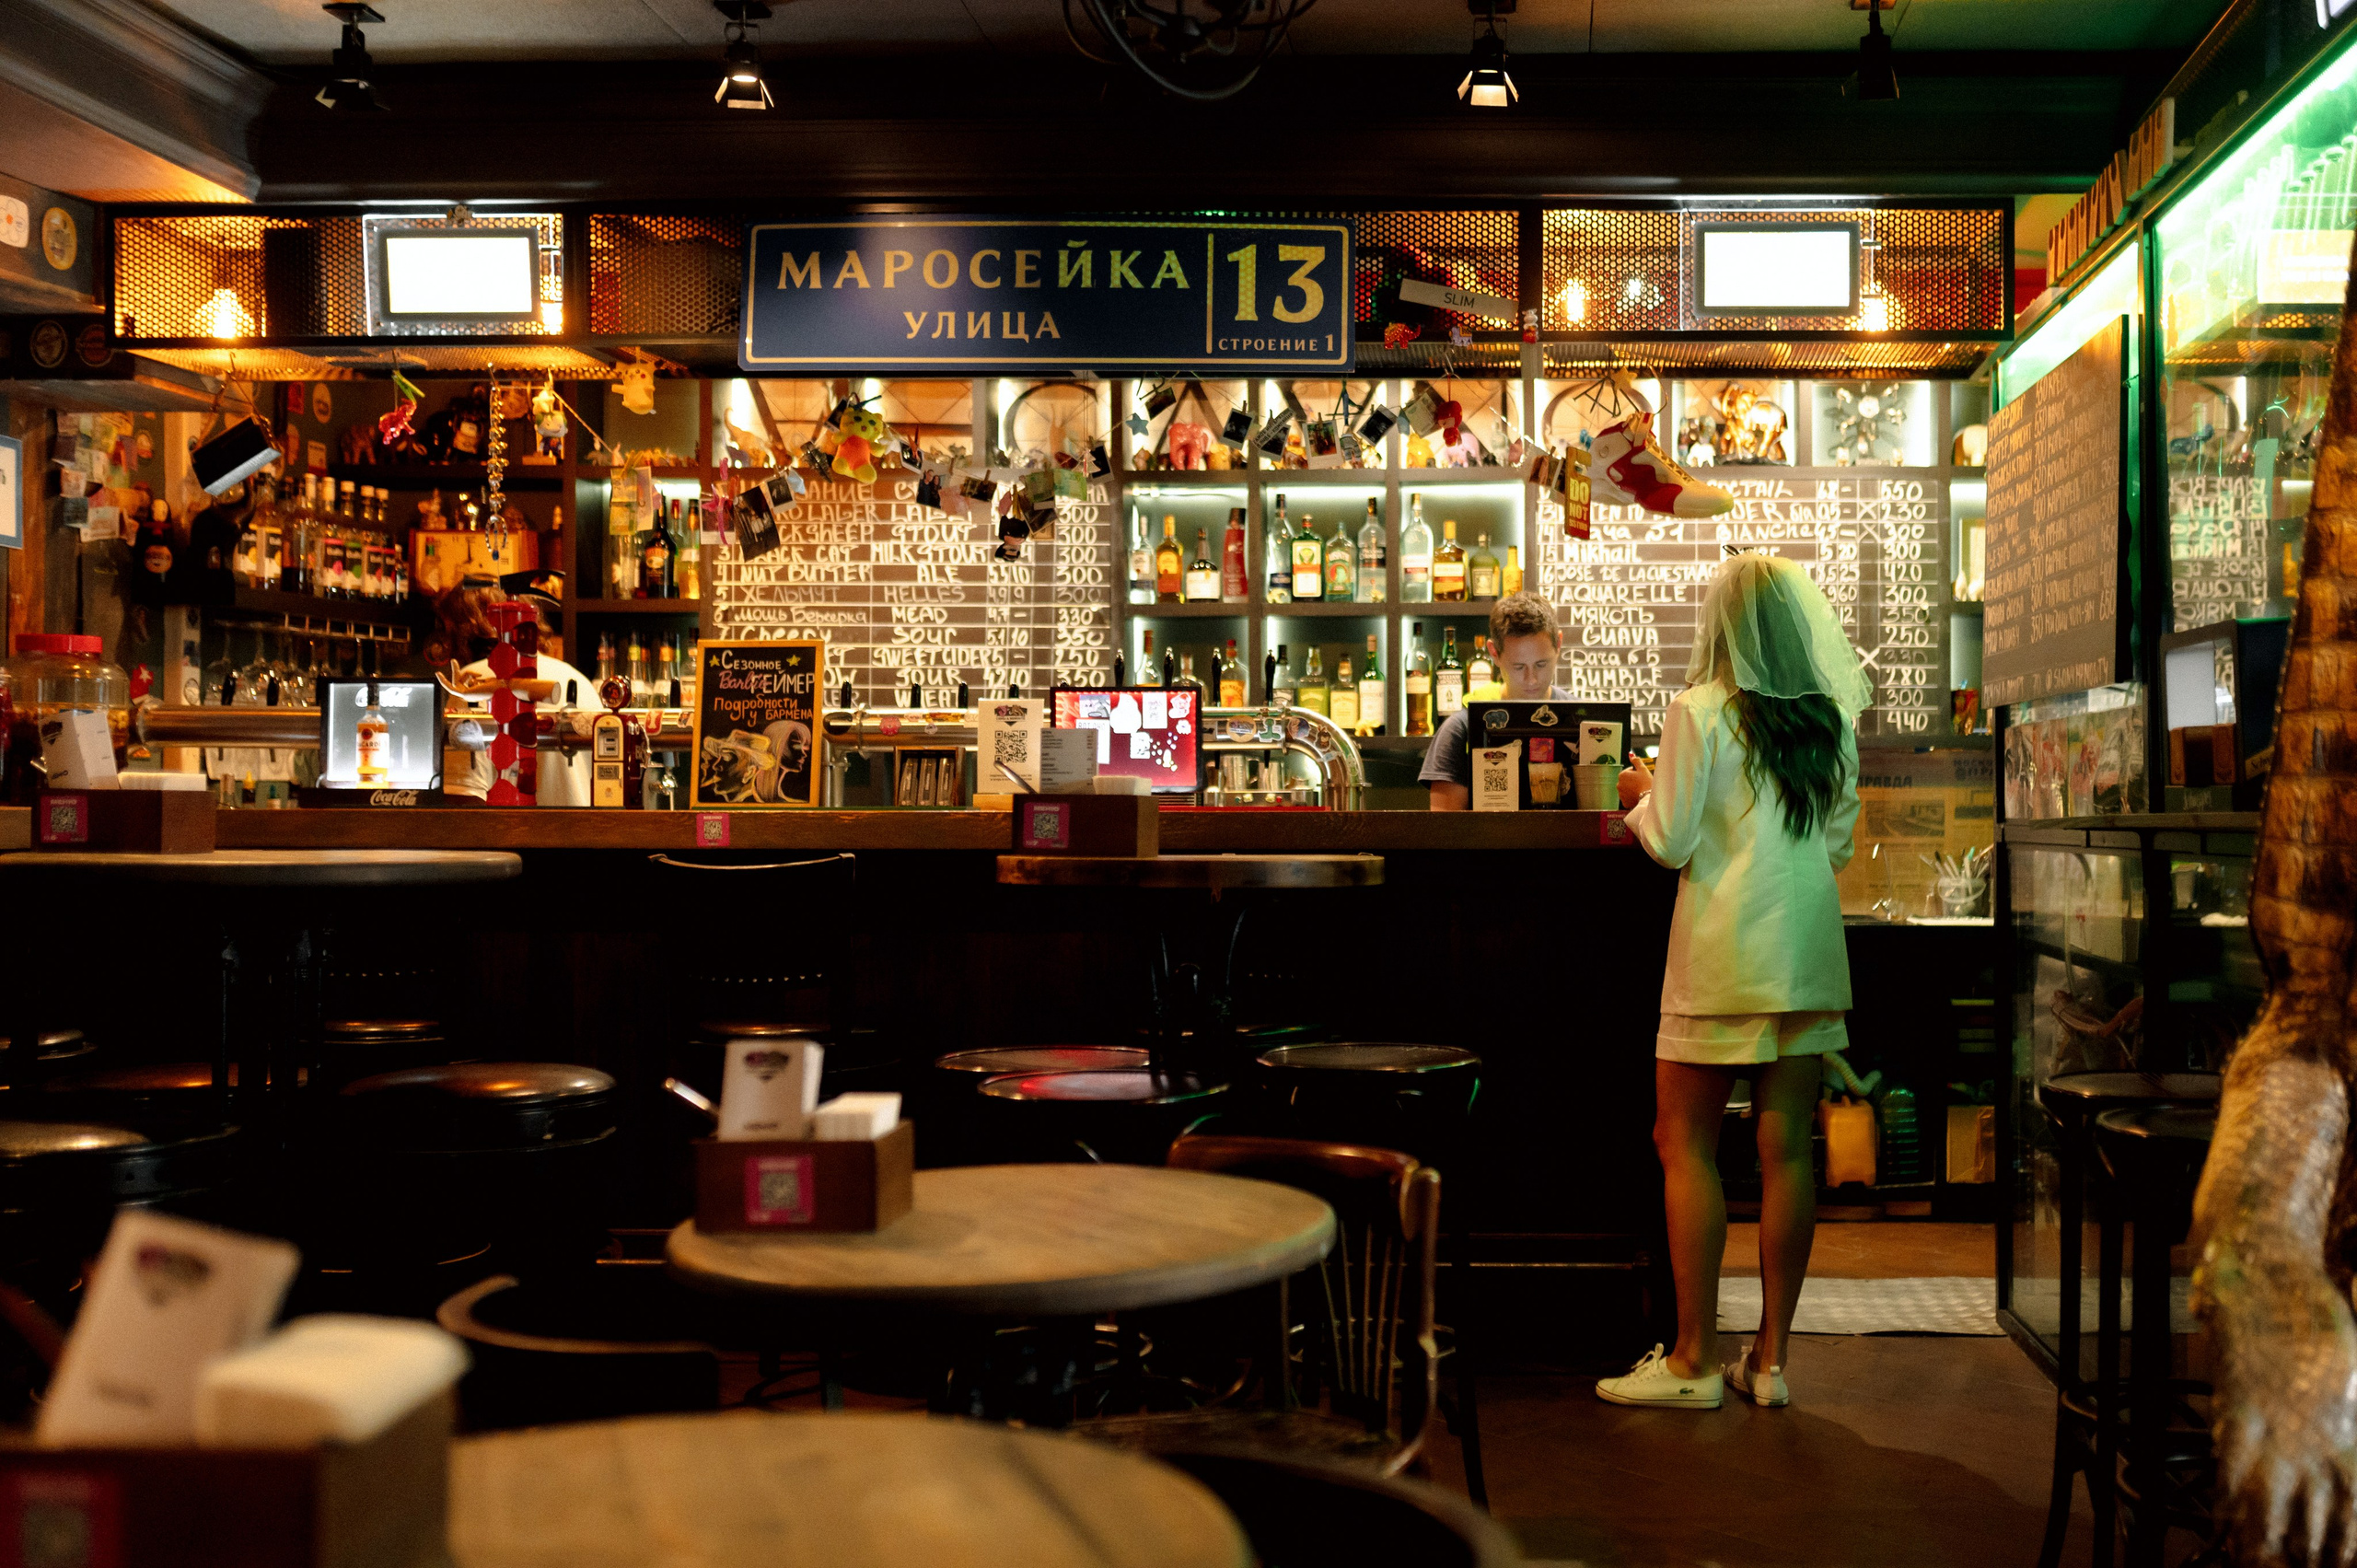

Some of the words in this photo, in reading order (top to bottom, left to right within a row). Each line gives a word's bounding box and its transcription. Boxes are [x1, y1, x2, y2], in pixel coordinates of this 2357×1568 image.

[777, 239, 1191, 290] МАРОСЕЙКА
[1226, 244, 1326, 324] 13
[1444, 293, 1475, 308] SLIM
[904, 310, 1062, 343] УЛИЦА
[1218, 337, 1318, 352] СТРОЕНИЕ
[1324, 333, 1336, 352] 1
[1569, 478, 1589, 505] DO
[1881, 481, 1923, 501] 550
[1059, 505, 1099, 524] 300
[1569, 503, 1588, 521] NOT
[1883, 502, 1926, 521] 230
[1059, 525, 1097, 544] 300
[1884, 523, 1925, 542] 300
[1059, 546, 1097, 563] 300
[1884, 542, 1922, 562] 300
[917, 565, 963, 585] ALE
[1057, 565, 1103, 585] 300
[1538, 564, 1554, 584] 16
[1558, 564, 1594, 582] JOSE
[1884, 563, 1922, 582] 420
[884, 586, 966, 603] HELLES
[1057, 587, 1102, 603] 300
[1560, 585, 1687, 604] AQUARELLE
[1885, 586, 1927, 604] 300
[2099, 587, 2115, 621] 650
[891, 607, 948, 625] MEAD
[1058, 607, 1094, 626] 330
[1570, 606, 1655, 625] МЯКОТЬ
[1883, 606, 1929, 624] 350
[1058, 627, 1104, 646] 350
[1582, 626, 1658, 646] GUAVA
[1885, 627, 1929, 647] 250
[1055, 648, 1100, 667] 250
[1058, 668, 1106, 688] 350
[1572, 667, 1662, 689] BUMBLE
[1886, 667, 1927, 686] 280
[714, 694, 798, 721] Подробности
[1887, 689, 1923, 707] 300
[765, 709, 814, 721] БАРМЕНА
[1887, 710, 1928, 734] 440
